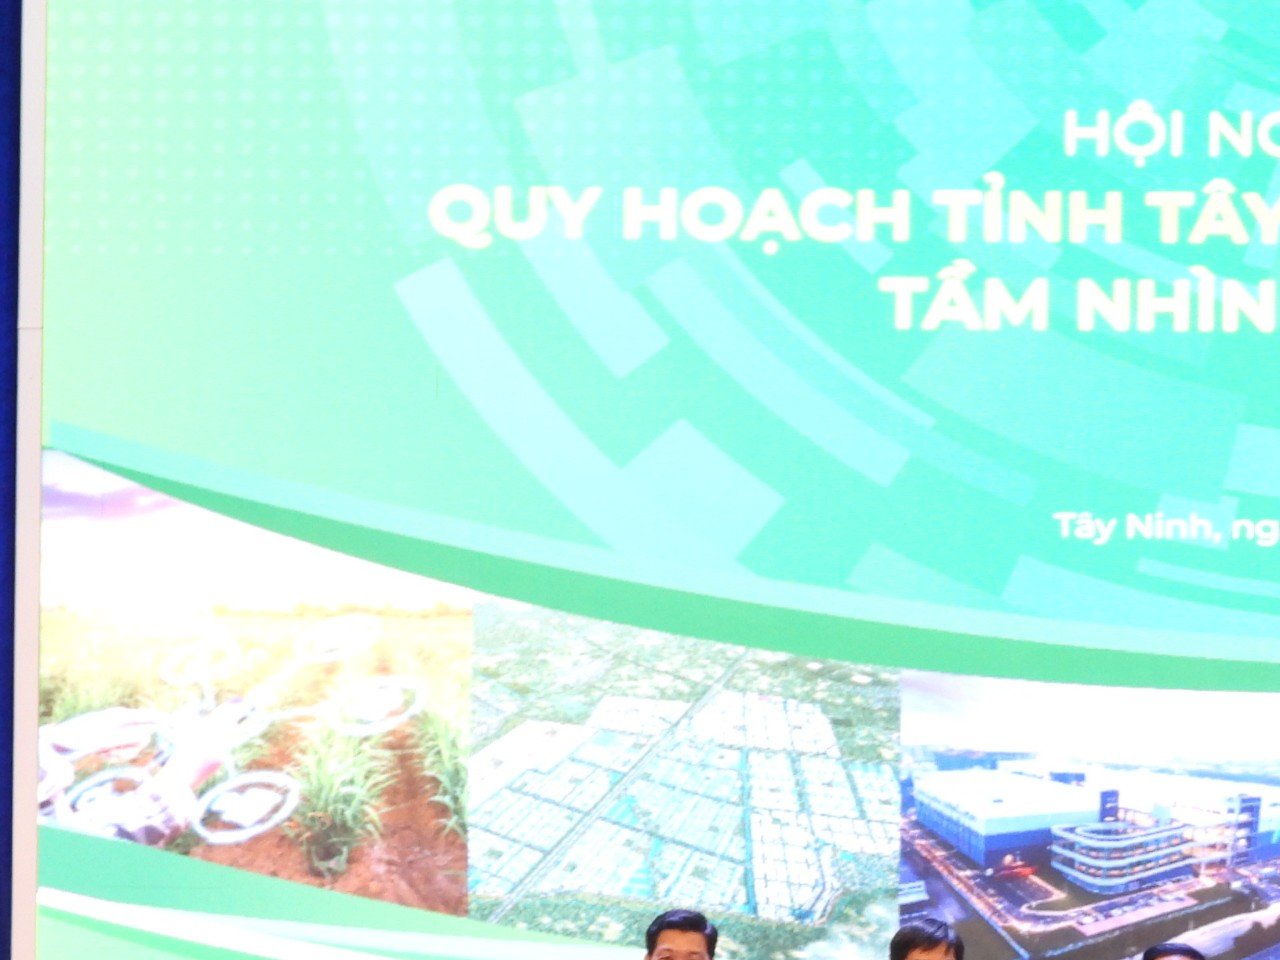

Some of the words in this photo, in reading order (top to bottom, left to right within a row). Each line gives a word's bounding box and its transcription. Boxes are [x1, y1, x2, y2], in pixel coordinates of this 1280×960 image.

[1064, 100, 1183, 167] HỘI
[427, 183, 604, 248] QUY
[623, 186, 910, 255] HOẠCH
[932, 170, 1123, 244] TỈNH
[878, 258, 1049, 332] TẦM
[1077, 265, 1277, 333] NHÌN
[1053, 511, 1117, 545] Tây
[1126, 512, 1222, 544] Ninh,
